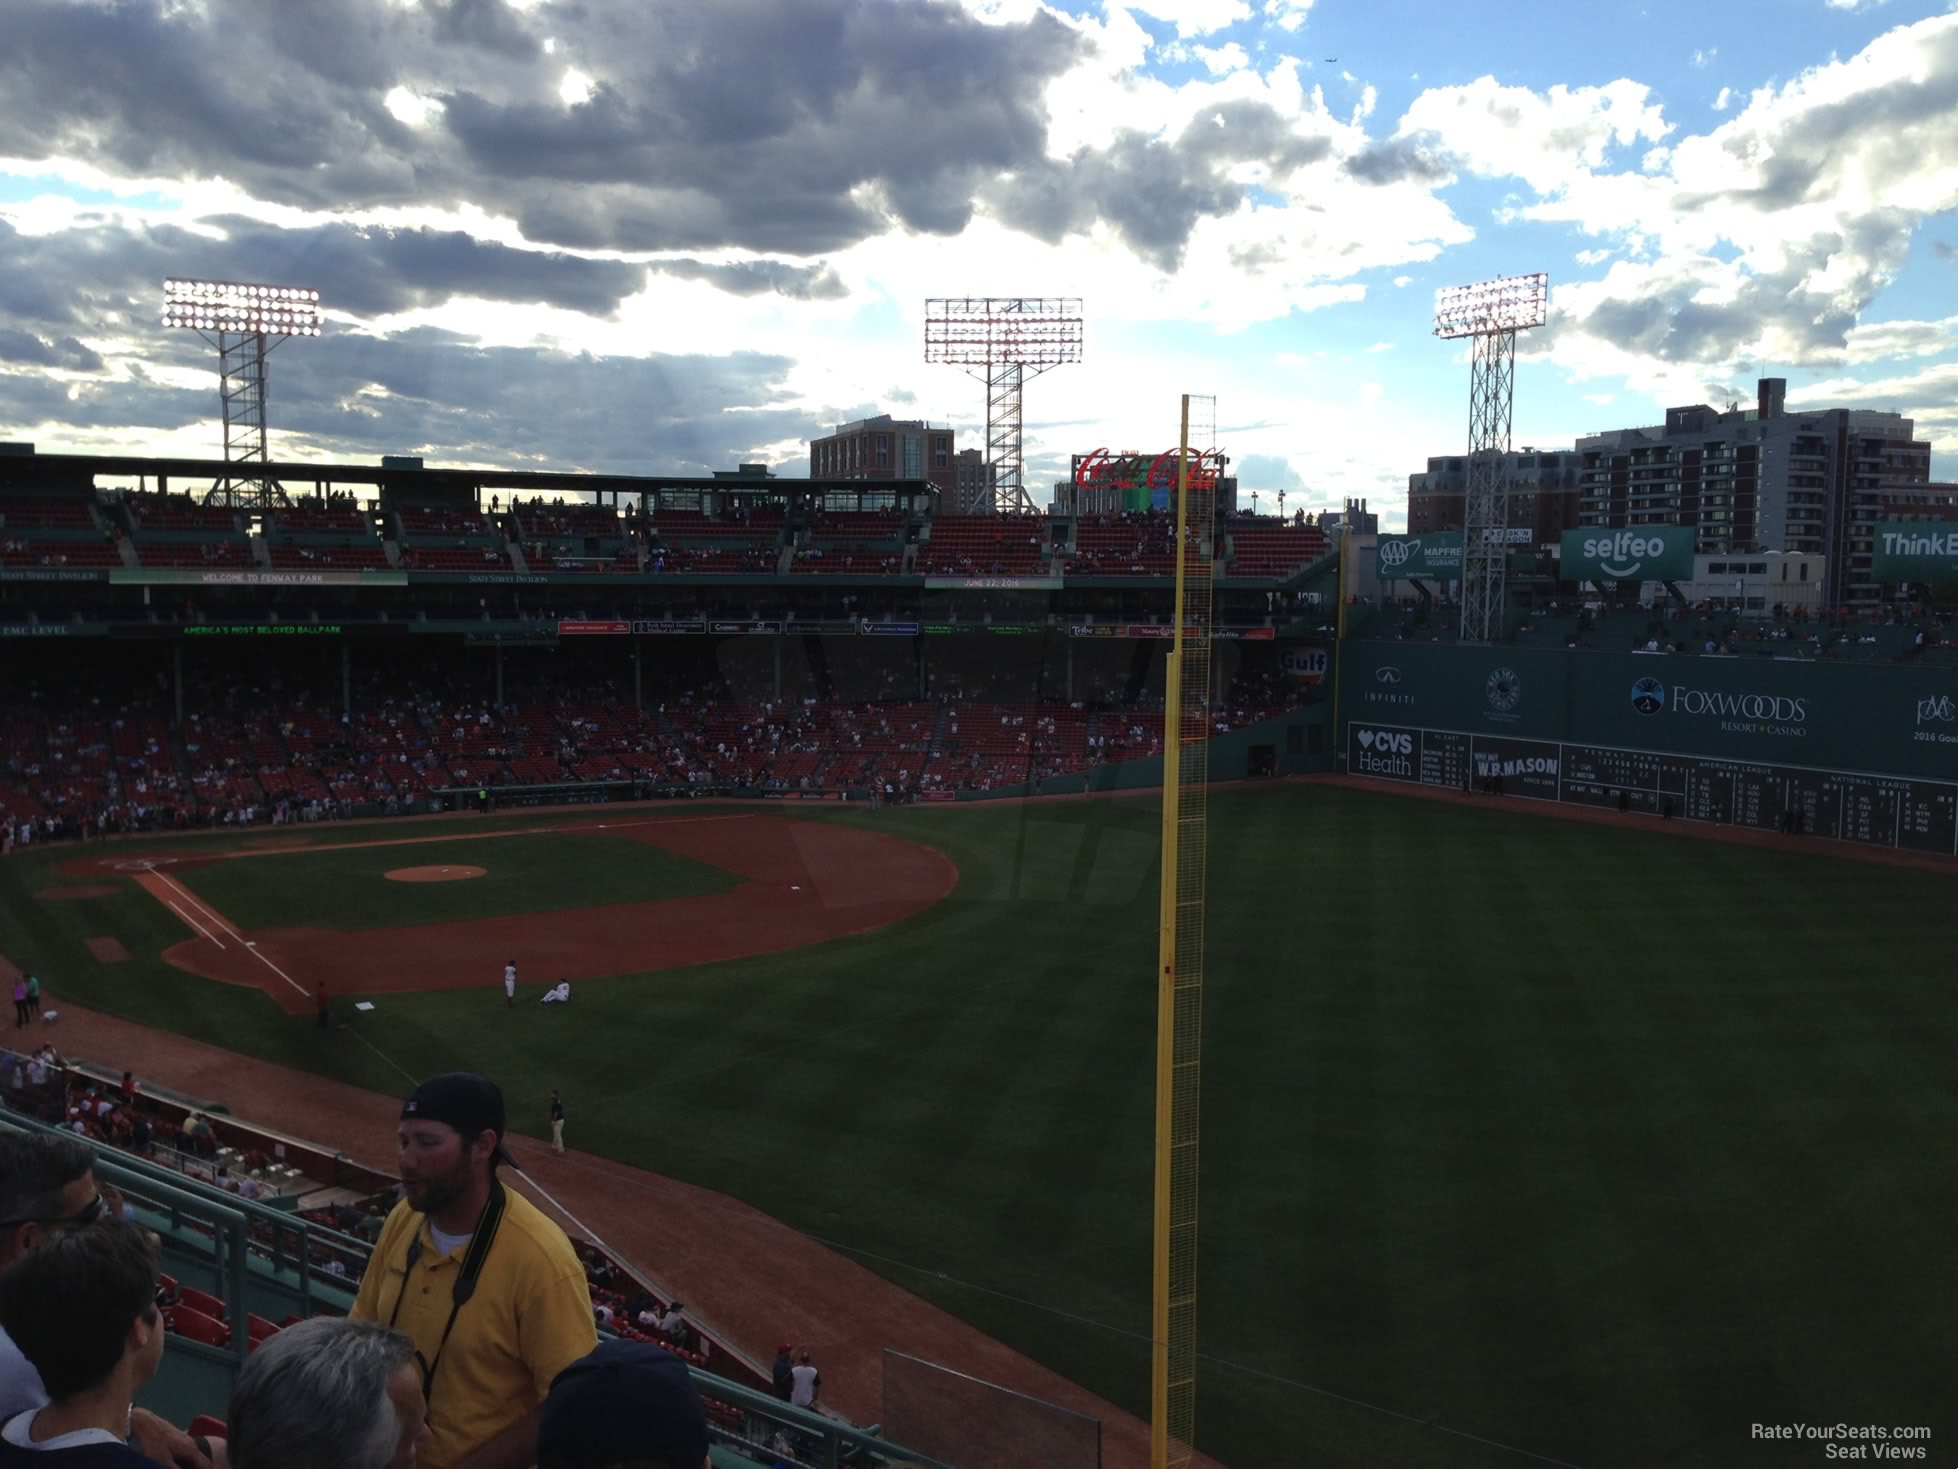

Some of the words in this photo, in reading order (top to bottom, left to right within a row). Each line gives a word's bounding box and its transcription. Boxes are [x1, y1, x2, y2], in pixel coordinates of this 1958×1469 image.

[1424, 548, 1462, 556] MAPFRE
[1426, 559, 1460, 567] INSURANCE
[202, 573, 244, 582] WELCOME
[261, 574, 298, 582] FENWAY
[300, 574, 323, 582] PARK
[469, 575, 490, 583] STATE
[490, 575, 515, 583] STREET
[516, 575, 549, 583] PAVILION
[964, 579, 983, 587] JUNE
[1001, 579, 1020, 587] 2016
[32, 626, 68, 635] LEVEL
[184, 626, 229, 634] AMERICA'S
[231, 626, 254, 634] MOST
[257, 626, 295, 634] BELOVED
[1072, 626, 1093, 636] Tribe
[1281, 651, 1325, 671] Gulf
[1364, 691, 1415, 704] INFINITI
[1672, 686, 1806, 722] FOXWOODS
[1720, 722, 1757, 733] RESORT
[1767, 725, 1806, 737] CASINO
[1913, 731, 1936, 742] 2016
[1375, 731, 1413, 754] CVS
[1359, 751, 1412, 776] Health
[1633, 754, 1660, 763] PARK
[1699, 761, 1739, 771] AMERICAN
[1742, 766, 1773, 775] LEAGUE
[1831, 775, 1872, 786] NATIONAL
[1876, 781, 1911, 790] LEAGUE
